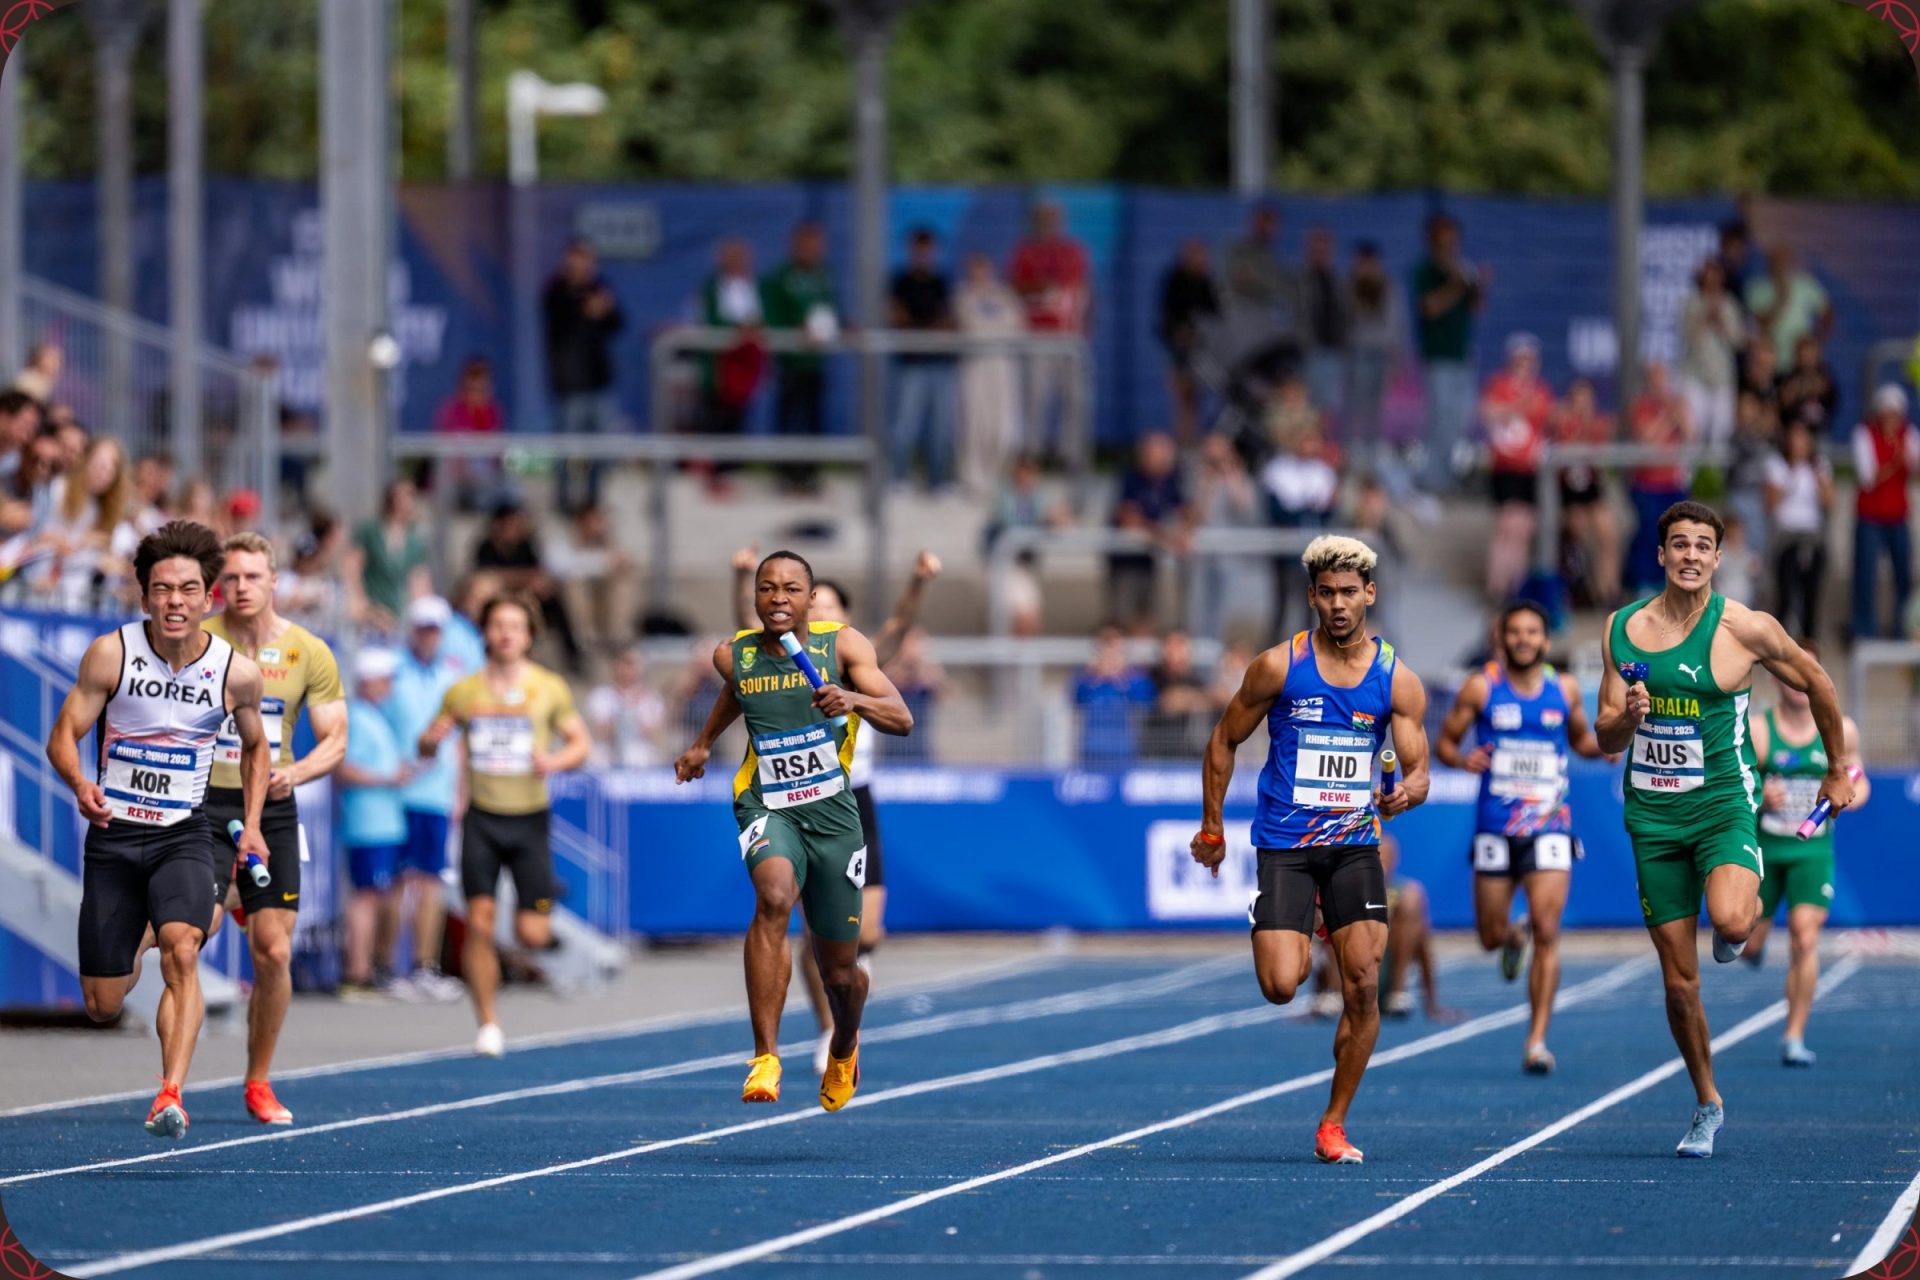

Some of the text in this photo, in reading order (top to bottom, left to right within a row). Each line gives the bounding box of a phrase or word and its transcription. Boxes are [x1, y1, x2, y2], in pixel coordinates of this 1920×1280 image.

[740, 676, 779, 695] SOUTH
[782, 667, 829, 690] AFRA
[128, 677, 214, 708] KOREA
[1649, 695, 1700, 718] TRALIA
[759, 729, 826, 750] RHINE-RUHR 2025
[1305, 734, 1371, 747] RHINE-RUHR 2025
[1674, 725, 1695, 736] 2025
[116, 745, 191, 766] RHINE-RUHR 2025
[225, 750, 241, 760] RE
[1645, 741, 1687, 766] AUS
[772, 751, 825, 781] RSA
[1318, 754, 1357, 779] IND
[130, 768, 172, 795] KOR
[1651, 777, 1680, 788] REWE
[787, 786, 821, 803] REWE
[1319, 791, 1351, 803] REWE
[128, 806, 164, 822] REWE
